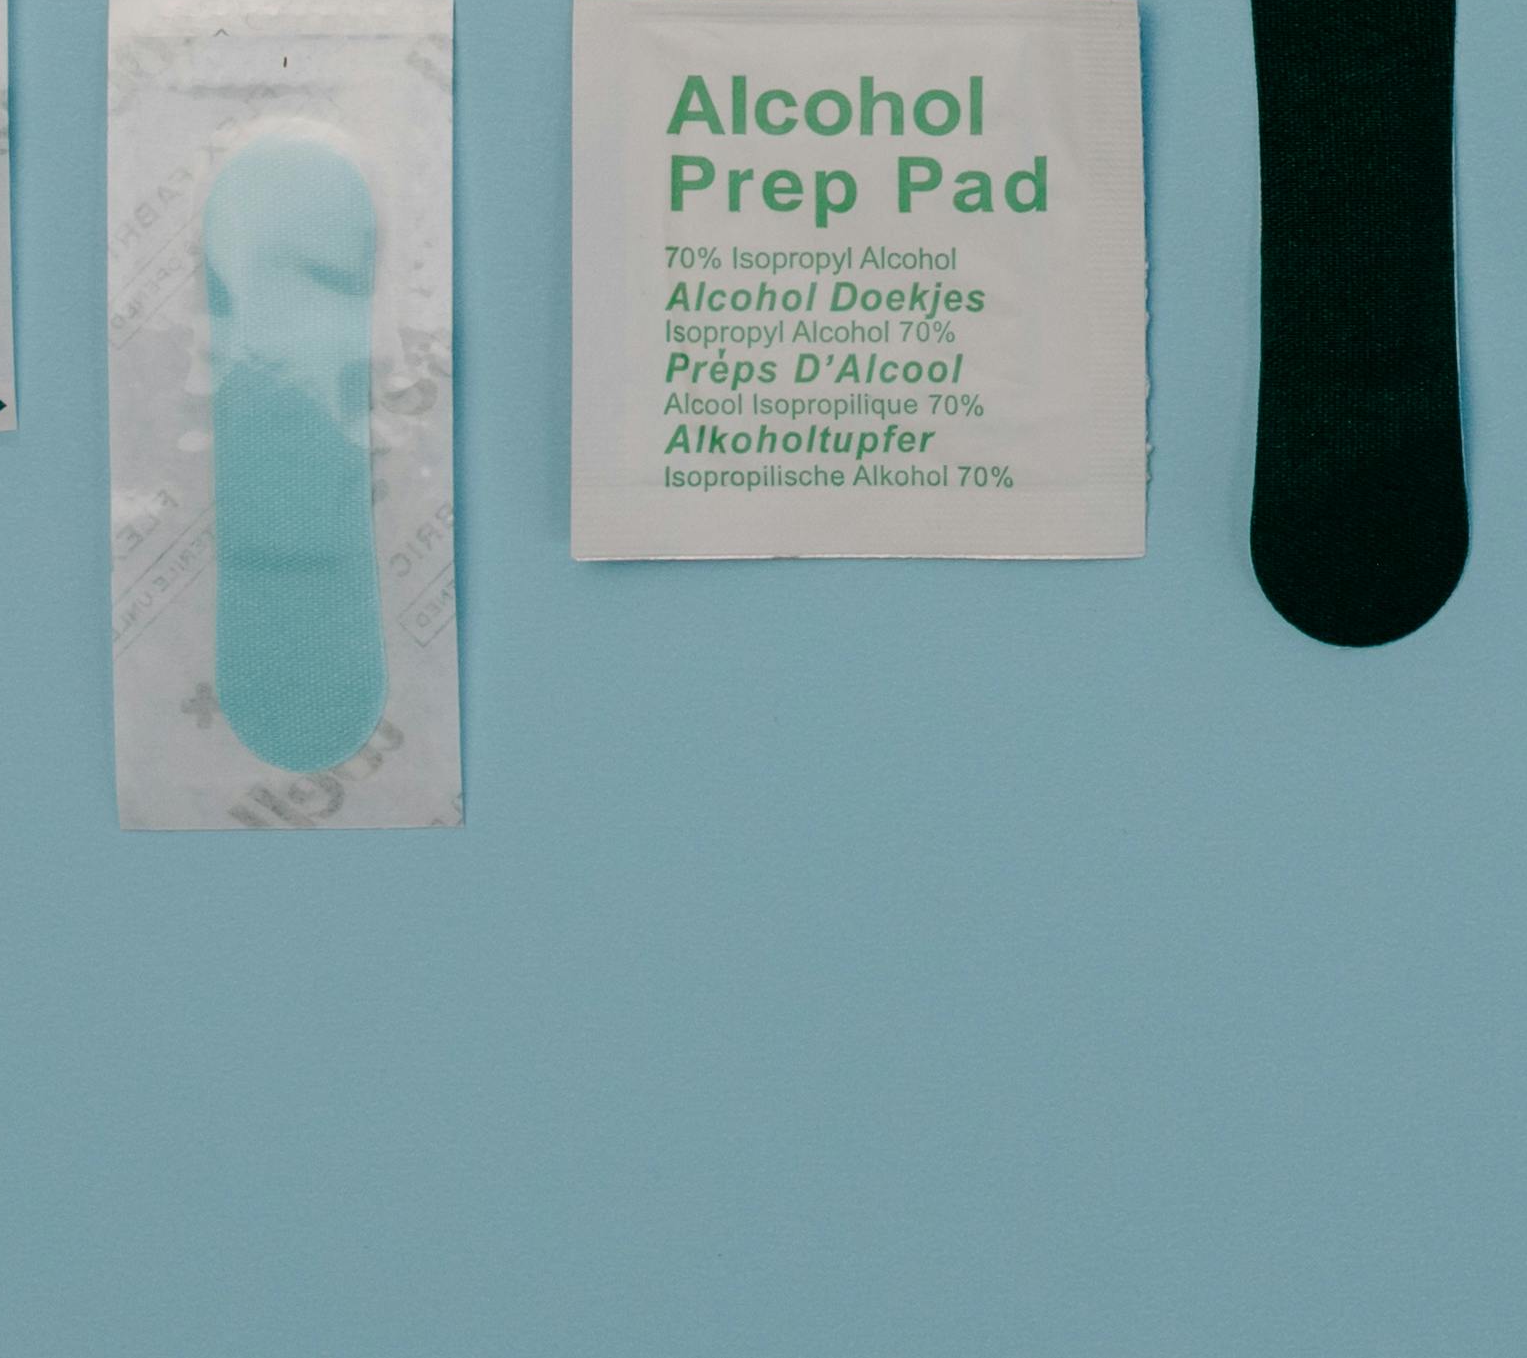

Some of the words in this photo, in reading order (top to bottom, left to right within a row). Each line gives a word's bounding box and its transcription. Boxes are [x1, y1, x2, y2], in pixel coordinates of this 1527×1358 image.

[666, 75, 984, 136] Alcohol
[670, 154, 857, 229] Prep
[897, 156, 1049, 214] Pad
[664, 247, 722, 271] 70%
[732, 247, 853, 276] Isopropyl
[860, 247, 957, 271] Alcohol
[665, 282, 816, 313] Alcohol
[830, 281, 985, 321] Doekjes
[665, 321, 784, 348] Isopropyl
[792, 321, 890, 344] Alcohol
[899, 321, 956, 344] 70%
[664, 392, 743, 416] Alcool
[753, 393, 918, 420] Isopropilique
[928, 394, 984, 417] 70%
[665, 423, 936, 460] Alkoholtupfer
[664, 465, 845, 492] Isopropilische
[853, 465, 948, 488] Alkohol
[958, 466, 1014, 489] 70%
